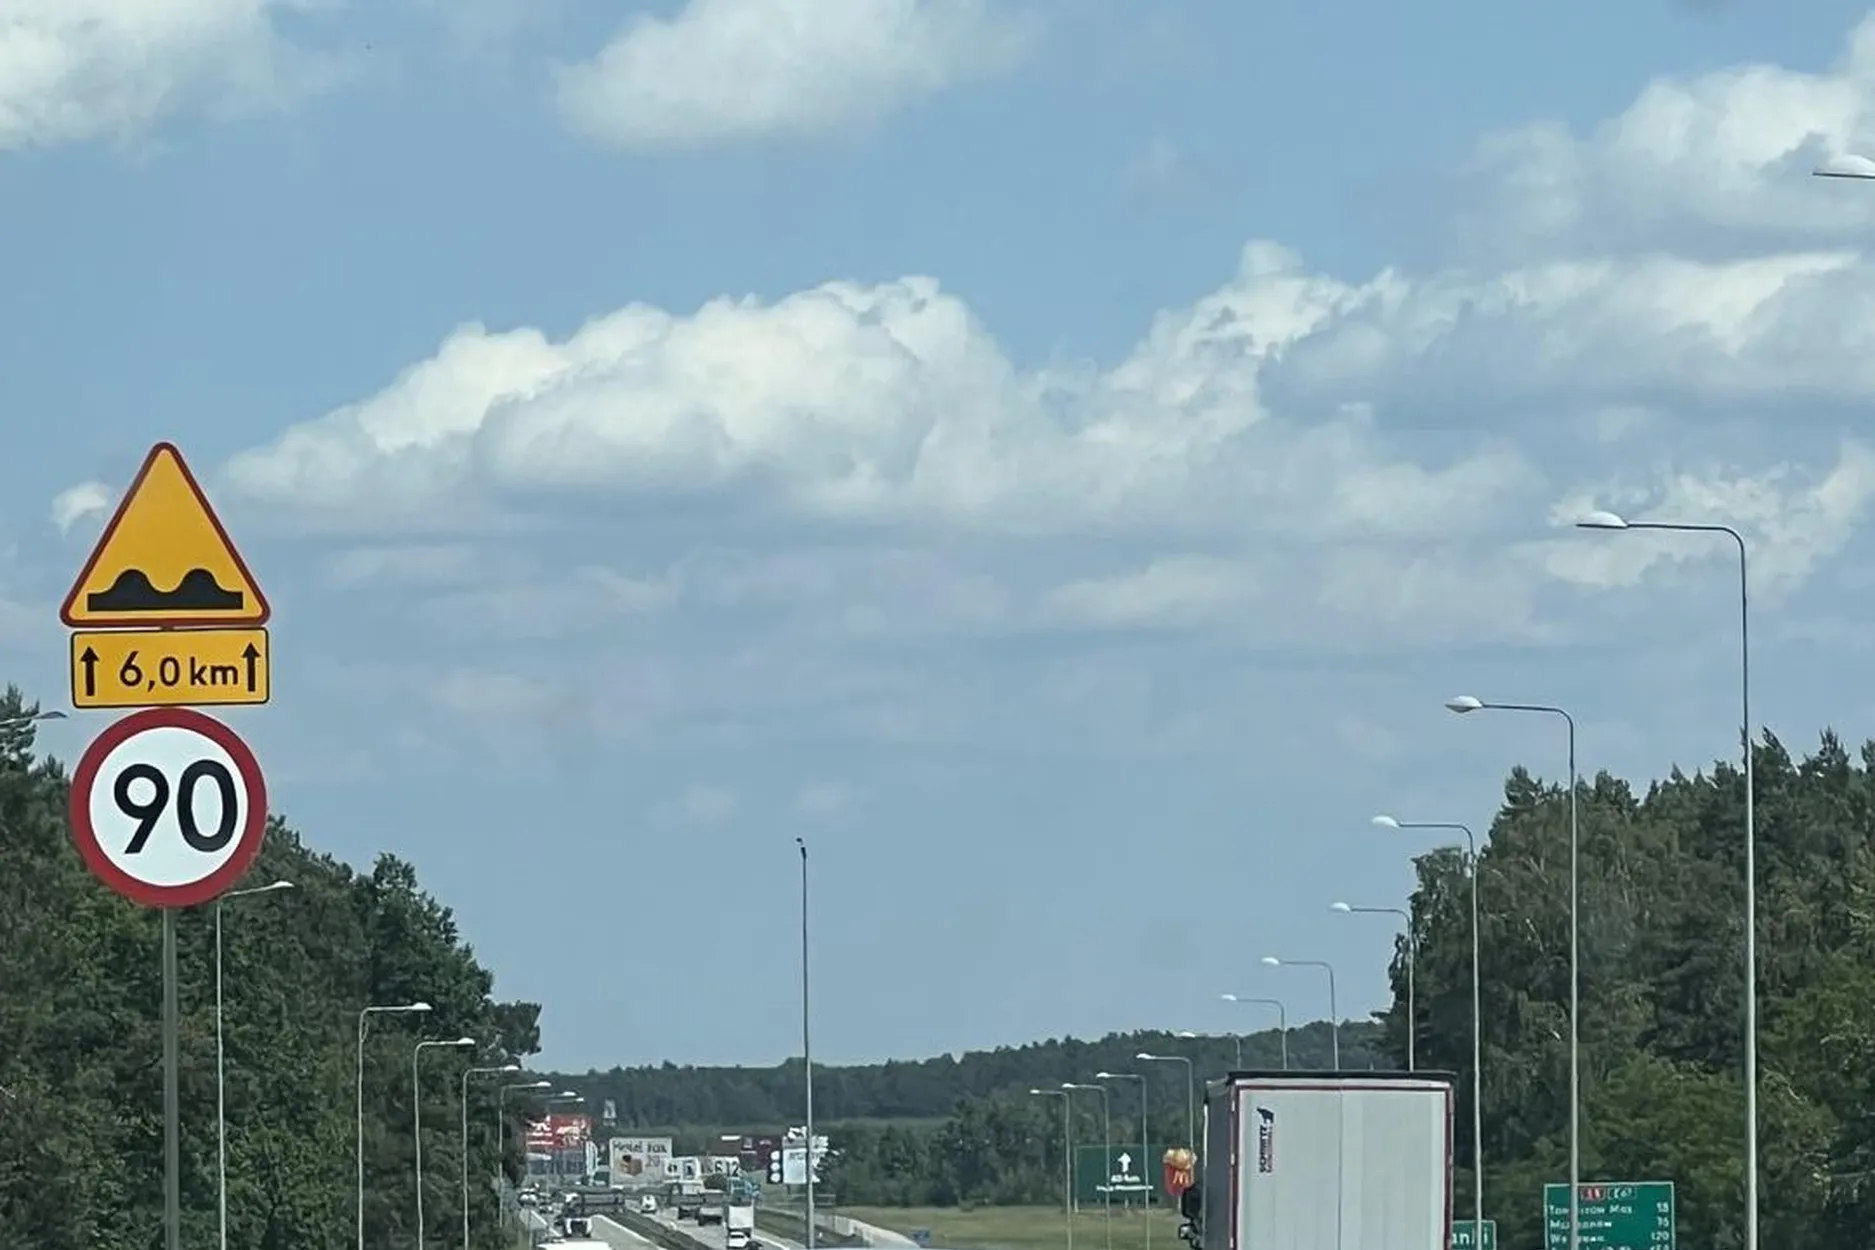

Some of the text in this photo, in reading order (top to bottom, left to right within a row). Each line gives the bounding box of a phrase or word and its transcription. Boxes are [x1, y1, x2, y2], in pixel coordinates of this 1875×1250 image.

[119, 650, 238, 692] 6,0 km
[113, 759, 238, 854] 90
